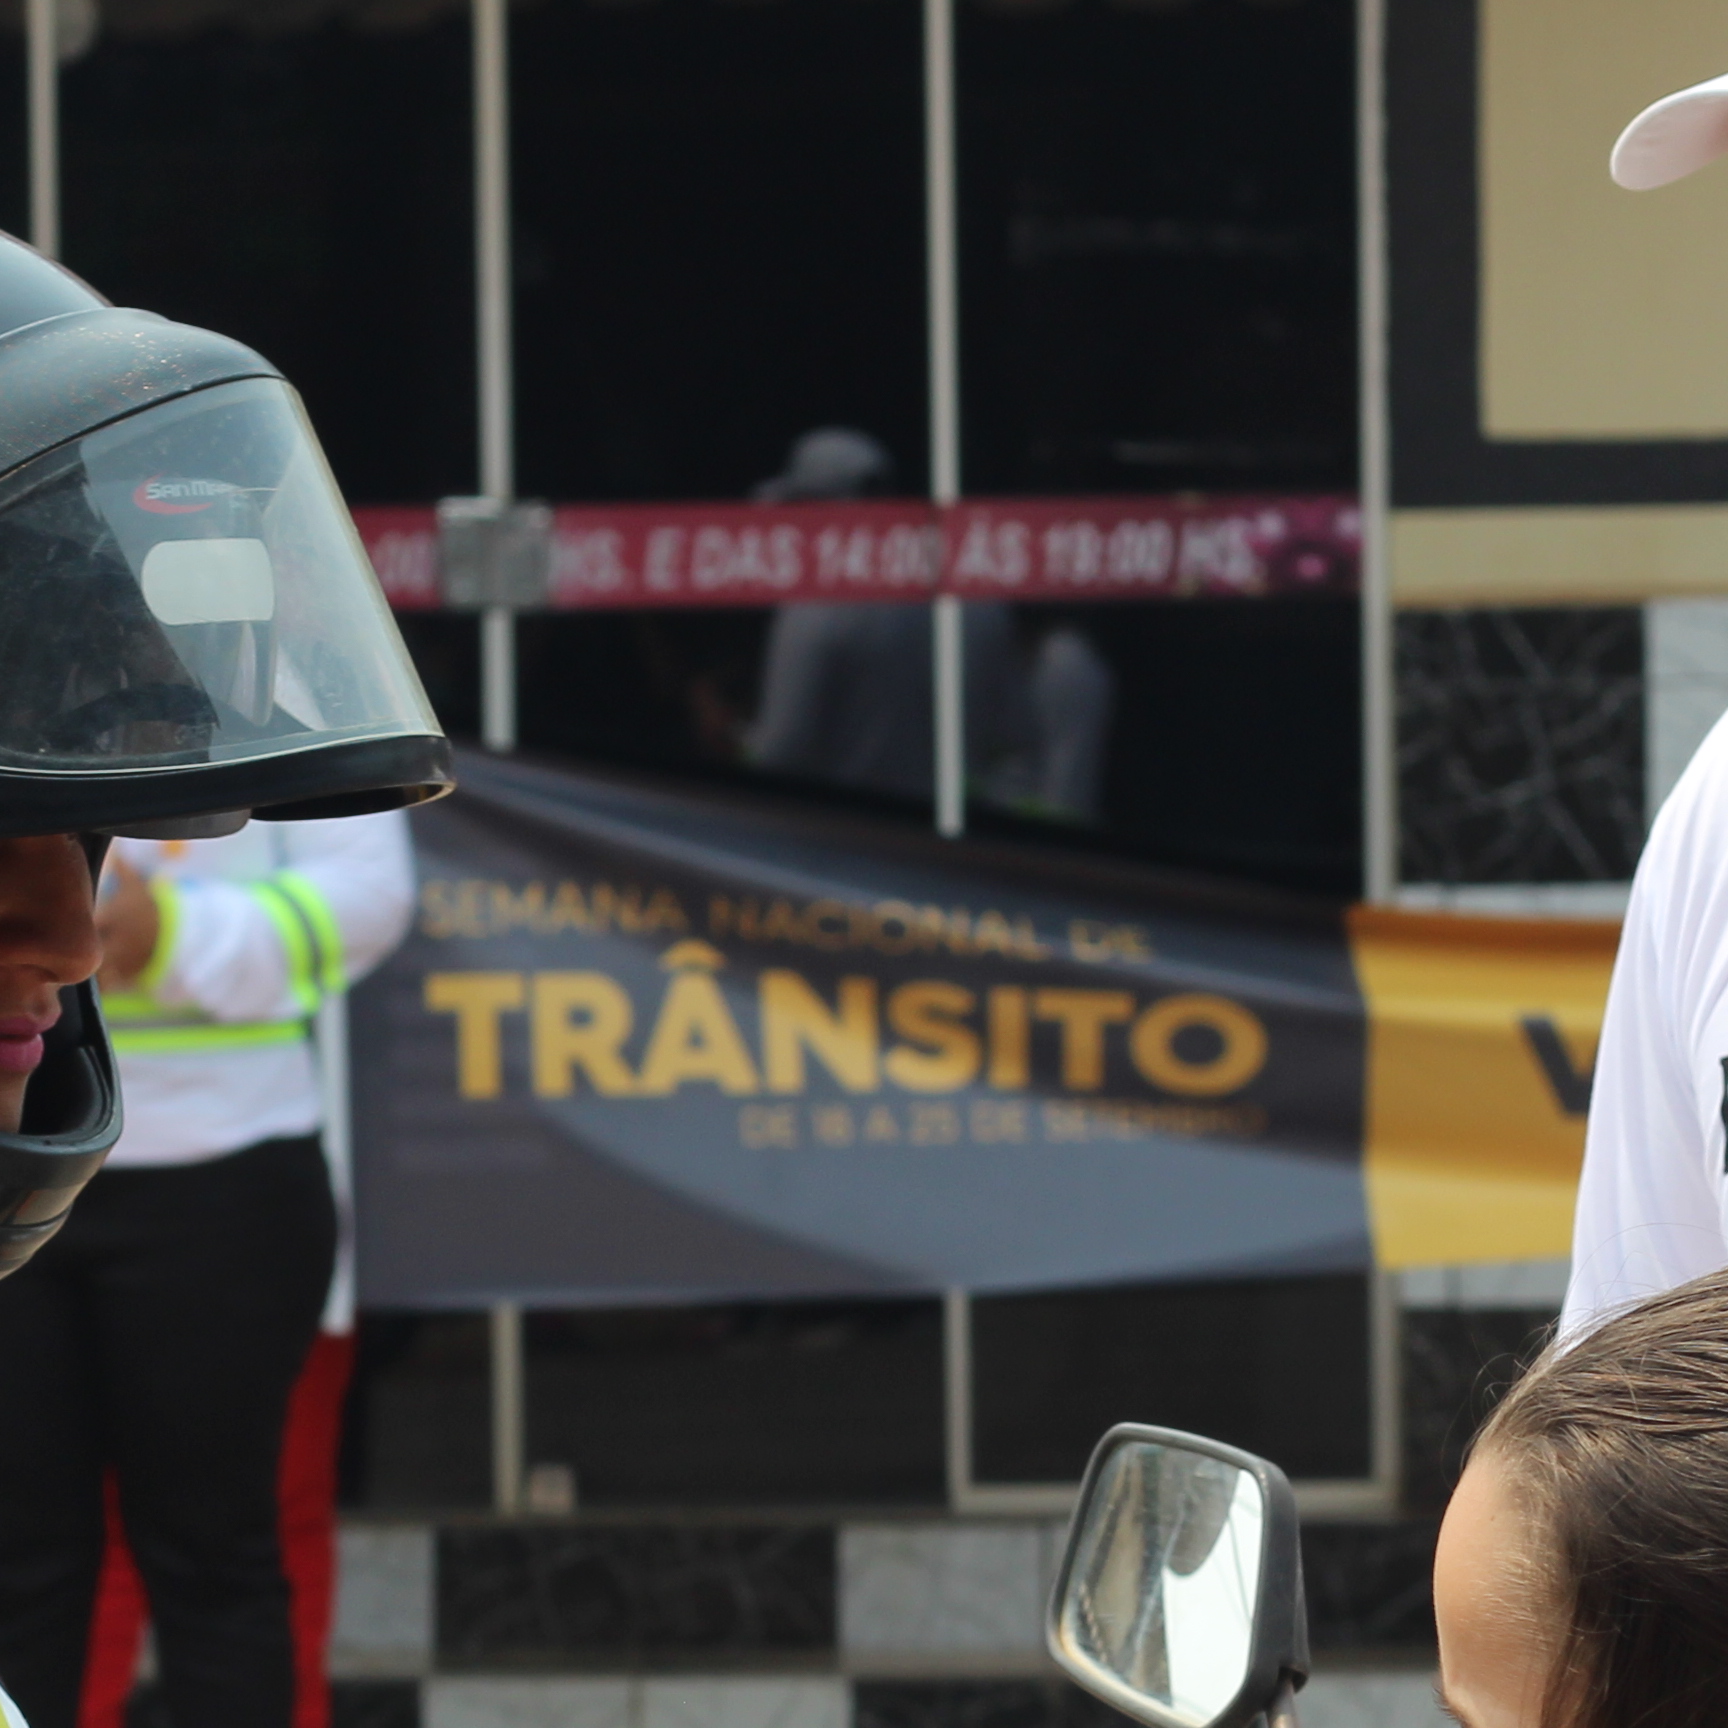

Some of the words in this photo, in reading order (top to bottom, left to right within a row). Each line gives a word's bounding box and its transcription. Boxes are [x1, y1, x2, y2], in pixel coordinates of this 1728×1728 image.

[643, 526, 676, 590] E
[689, 525, 800, 589] DAS
[419, 878, 689, 939] SEMANA
[708, 894, 1051, 962] NACIONAL
[1069, 914, 1155, 964] DE
[424, 939, 1269, 1099] TRÂNSITO
[739, 1104, 799, 1148] DE
[969, 1101, 1027, 1145] DE
